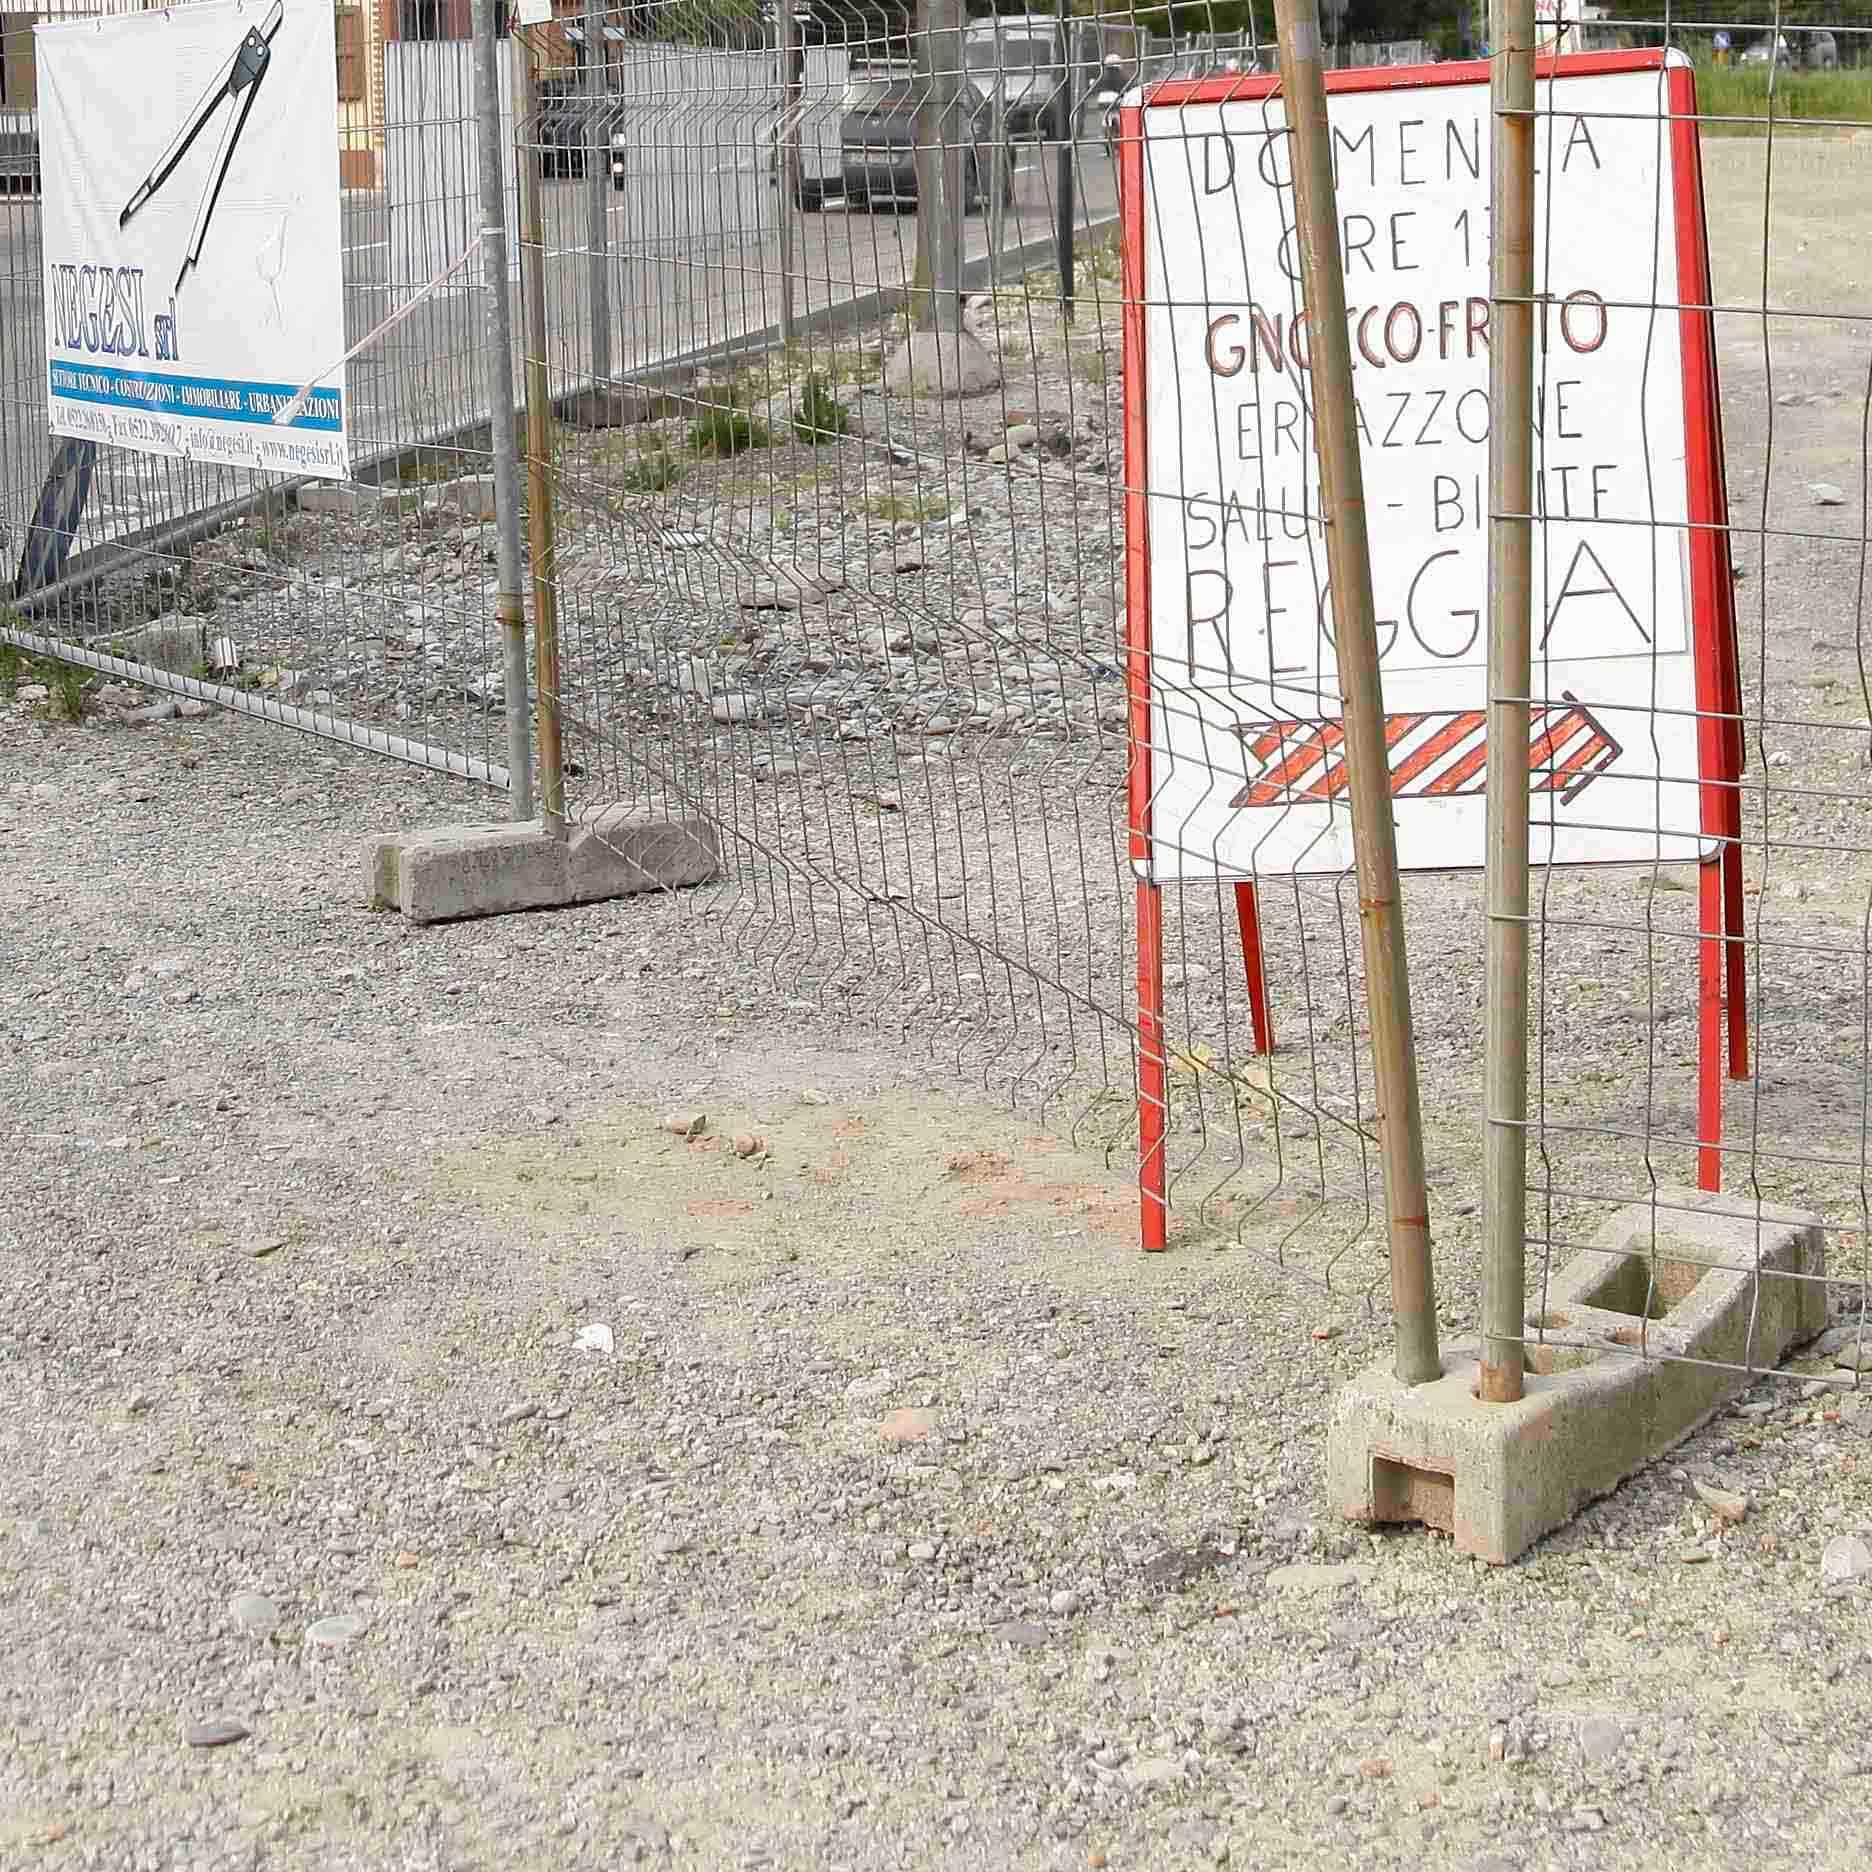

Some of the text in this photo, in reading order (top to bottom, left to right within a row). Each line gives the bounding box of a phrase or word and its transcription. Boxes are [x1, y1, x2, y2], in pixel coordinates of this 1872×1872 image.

[1203, 114, 1601, 195] DOMENA
[50, 263, 179, 361] NEGESI srl
[78, 372, 110, 395] TECNICO
[115, 377, 175, 405] COSTRUZIONI
[248, 392, 340, 420] URBANIAZIONI
[1237, 380, 1583, 459] ERAZZOE
[1186, 486, 1325, 550] SALU
[1433, 465, 1618, 532] BIITE
[1186, 538, 1652, 680] REGGA
